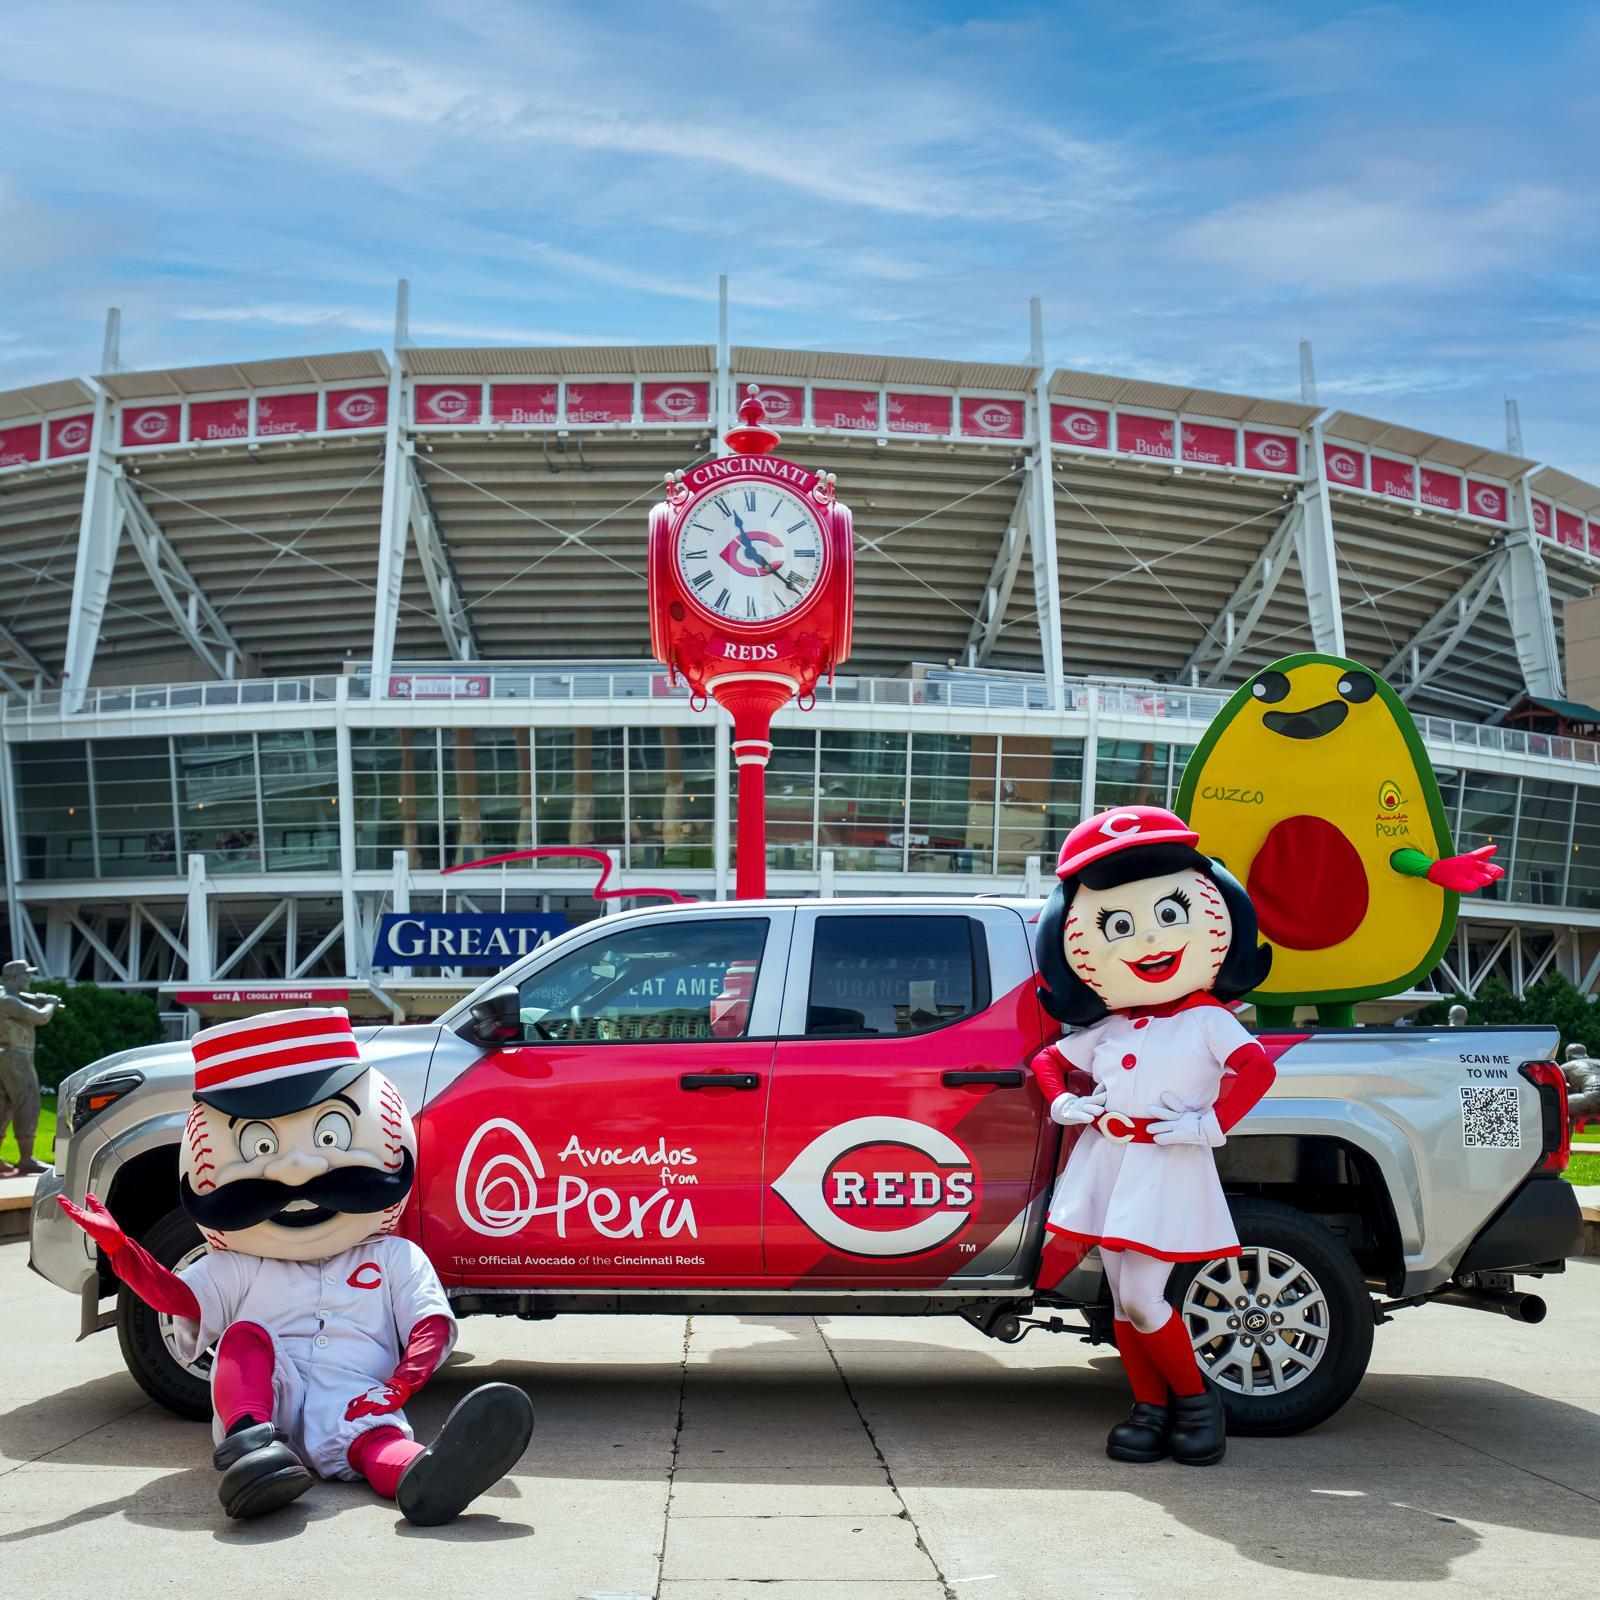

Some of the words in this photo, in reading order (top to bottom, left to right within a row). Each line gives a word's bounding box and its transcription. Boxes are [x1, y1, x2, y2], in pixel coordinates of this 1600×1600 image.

[667, 398, 697, 406] REDS
[763, 401, 791, 410] REDS
[349, 404, 376, 412] REDS
[985, 414, 1012, 423] REDS
[1073, 422, 1098, 432] REDS
[1265, 448, 1288, 459] REDS
[692, 458, 810, 487] CINCINNATI
[723, 643, 778, 661] REDS
[1201, 787, 1264, 804] CUZCO
[1099, 814, 1141, 838] C
[1376, 823, 1409, 838] Peru
[212, 992, 231, 1000] GATE
[232, 992, 240, 1001] A
[246, 992, 279, 1000] CROSLEY
[280, 992, 312, 1000] TERRACE
[1459, 1054, 1490, 1064] SCAN
[1492, 1055, 1510, 1065] ME
[1466, 1068, 1482, 1078] TO
[1484, 1069, 1508, 1079] WIN
[557, 1134, 698, 1167] Avocados
[659, 1166, 698, 1186] from
[833, 1172, 975, 1208] REDS
[556, 1175, 698, 1238] Peru
[959, 1243, 977, 1252] TM
[452, 1255, 476, 1265] The
[478, 1255, 522, 1265] Official
[525, 1255, 576, 1265] Avocado
[578, 1255, 591, 1265] of
[592, 1255, 611, 1265] the
[613, 1255, 673, 1265] Cincinnati
[675, 1255, 705, 1265] Reds
[346, 1262, 381, 1289] C
